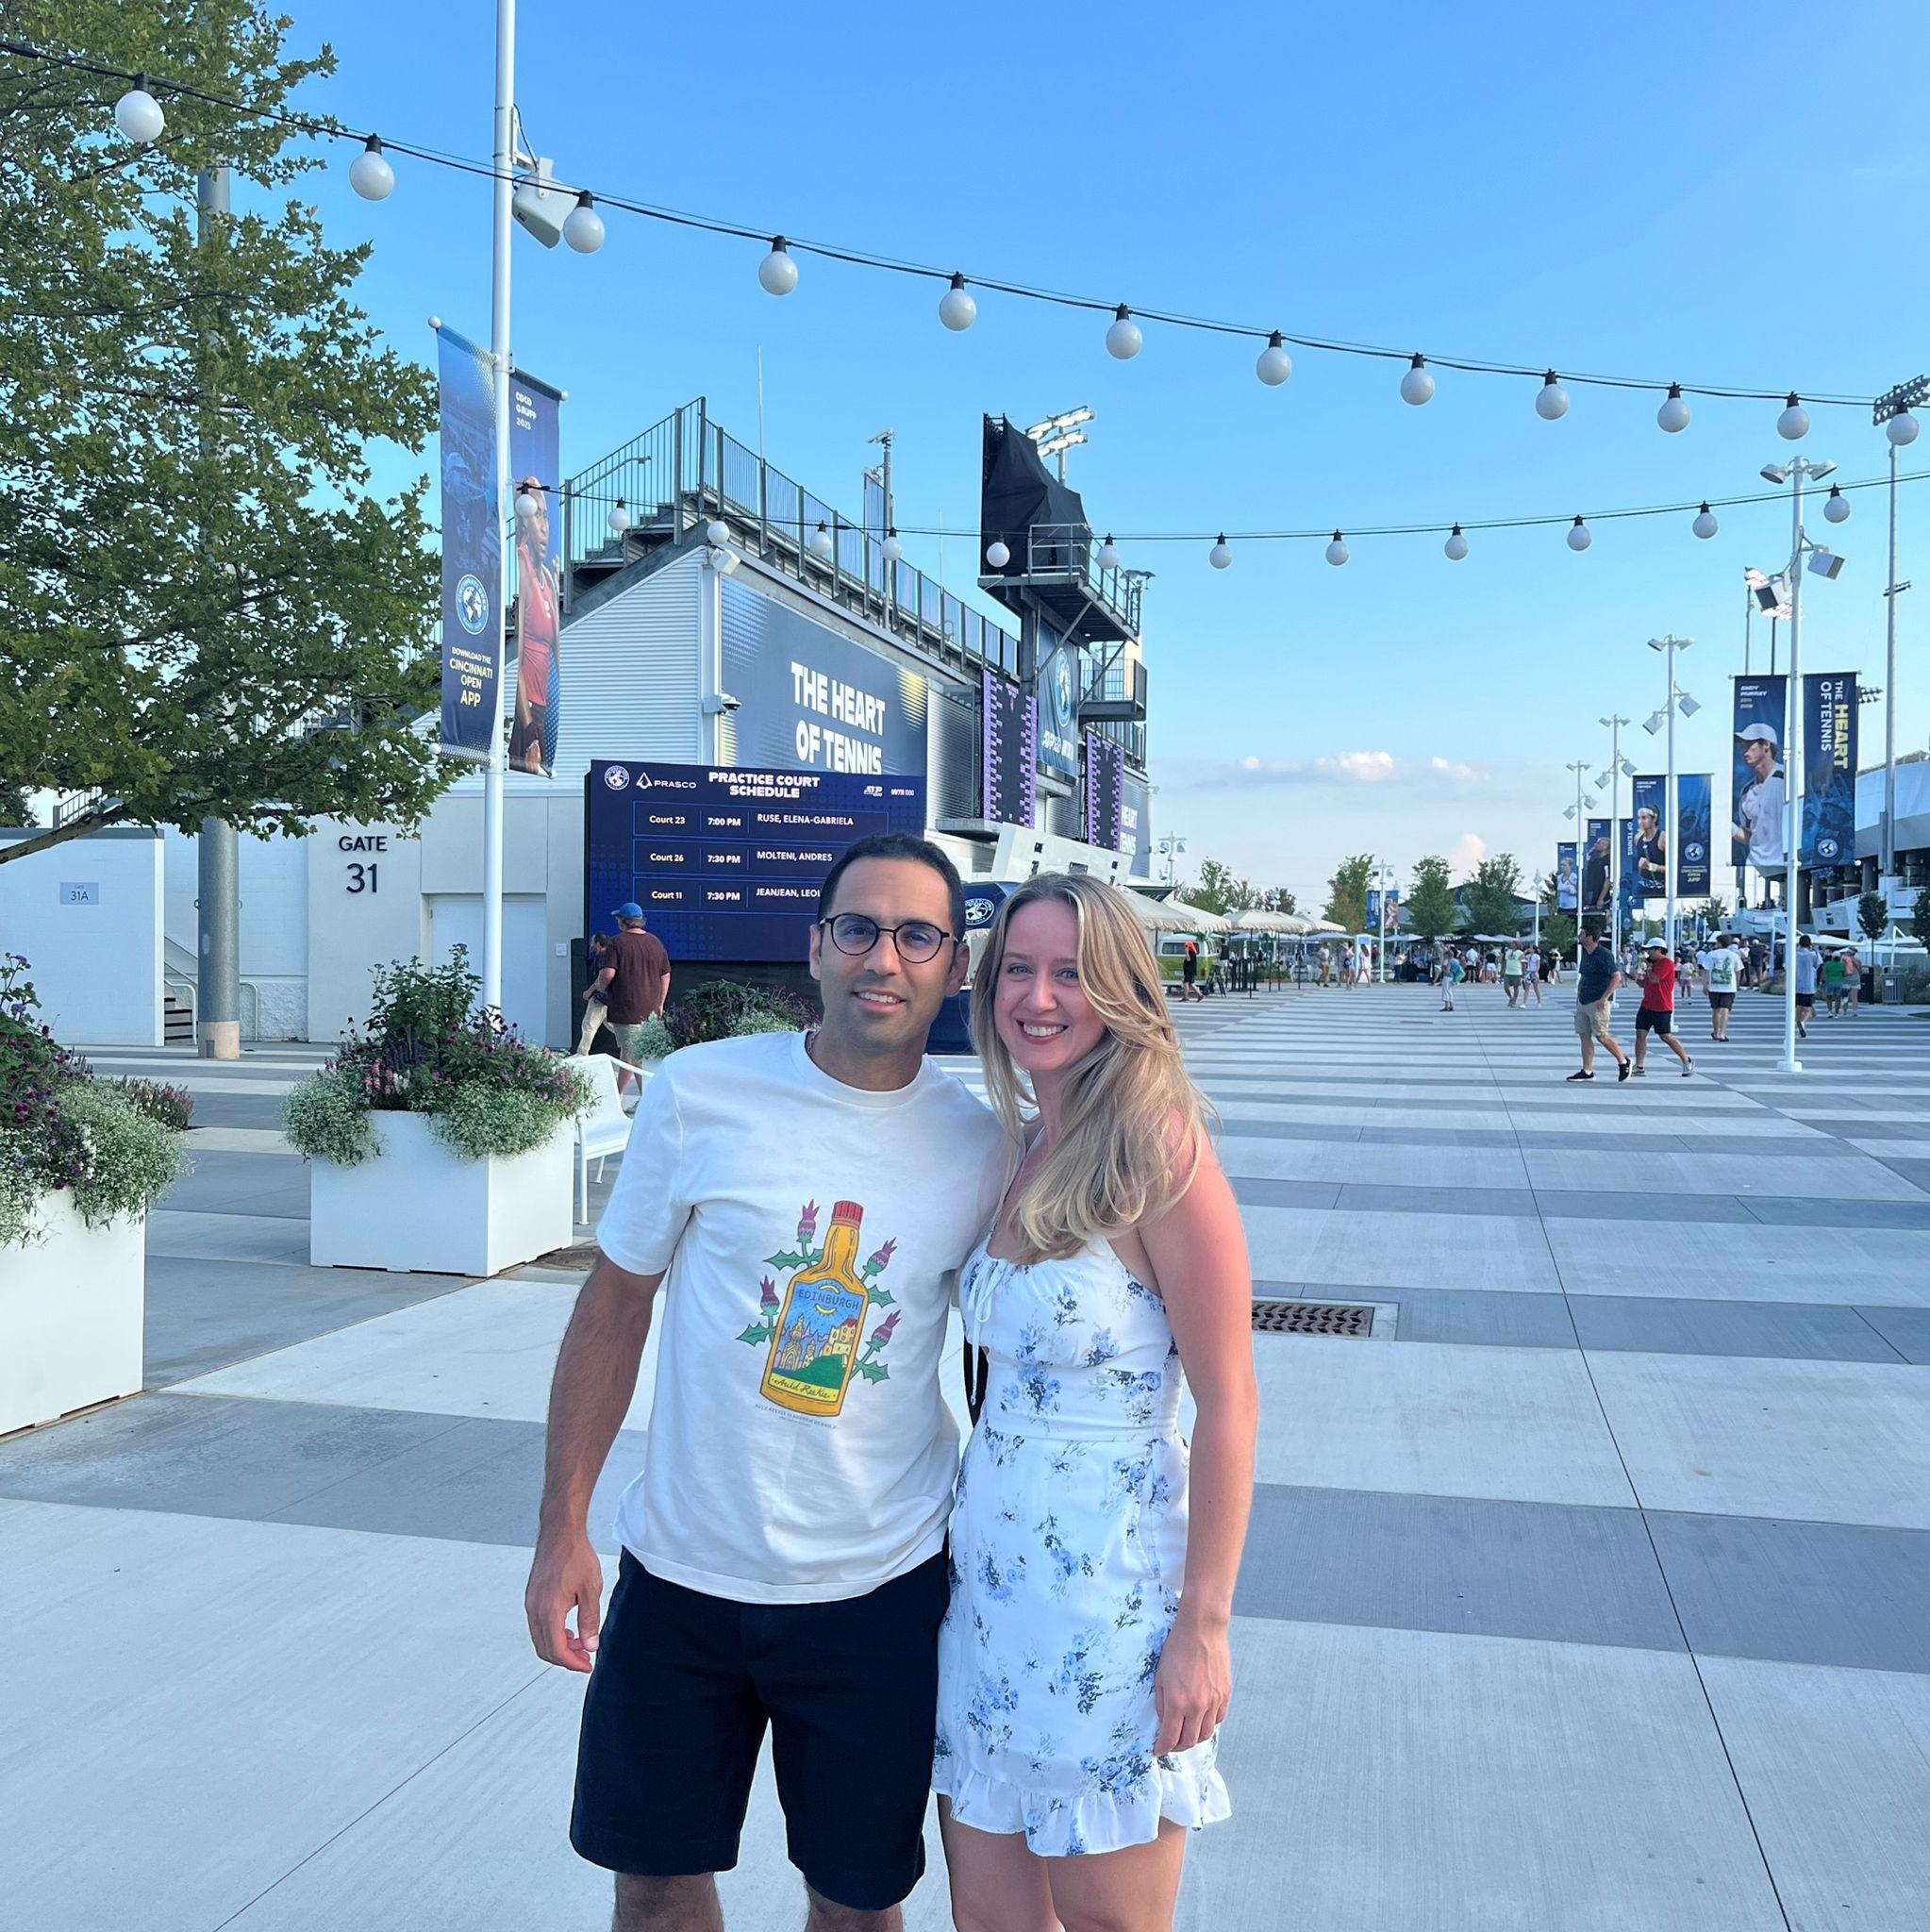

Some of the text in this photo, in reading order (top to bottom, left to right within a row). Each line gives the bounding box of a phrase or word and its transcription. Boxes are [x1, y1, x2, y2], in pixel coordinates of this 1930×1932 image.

[515, 391, 533, 407] COCO
[515, 404, 537, 420] GAUFF
[452, 646, 491, 664] DOWNLOAD THE
[449, 658, 492, 679] CINCINNATI
[460, 675, 482, 690] OPEN
[460, 690, 481, 708] APP
[790, 660, 886, 736] THE HEART
[1821, 681, 1833, 752] OF TENNIS
[1834, 680, 1849, 769] THE HEART
[795, 720, 882, 775] OF TENNIS
[654, 779, 697, 789] PRASCO
[708, 772, 821, 787] PRACTICE COURT
[729, 785, 800, 798] SCHEDULE
[649, 815, 686, 824] Court 23
[707, 817, 741, 826] 7:00 PM
[757, 813, 854, 825] RUSE, ELENA-GABRIELA
[339, 836, 388, 851] GATE
[650, 853, 685, 862] Court 26
[707, 855, 741, 864] 7:30 PM
[757, 851, 833, 861] MOLTENI, ANDRES
[346, 862, 377, 893] 31
[71, 891, 89, 902] 31A
[651, 891, 683, 900] Court 11
[707, 891, 740, 901] 7:30 PM
[756, 888, 800, 898] JEANJEAN,
[798, 1289, 859, 1310] EDINBURGH
